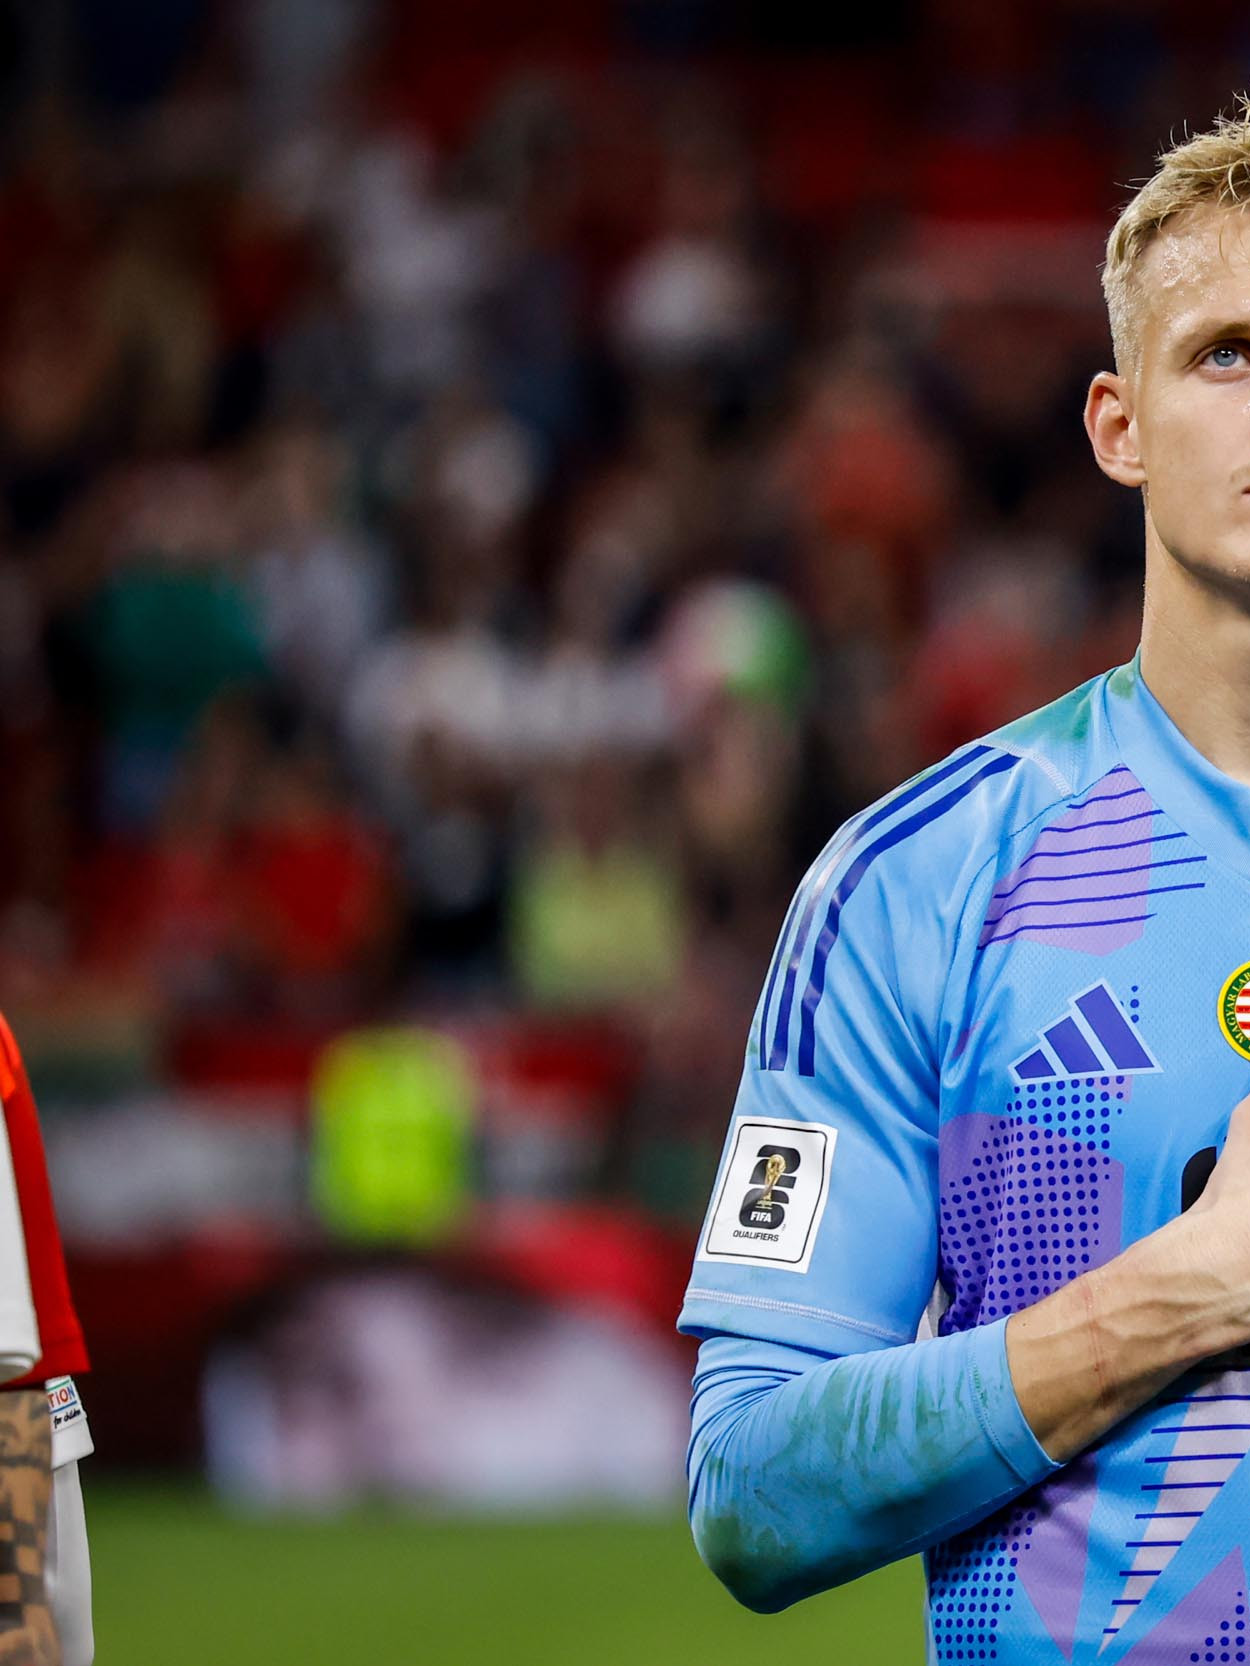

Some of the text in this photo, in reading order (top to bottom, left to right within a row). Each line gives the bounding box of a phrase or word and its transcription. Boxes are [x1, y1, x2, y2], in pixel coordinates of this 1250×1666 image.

[1226, 994, 1246, 1044] MAGYAR
[750, 1211, 772, 1223] FIFA
[732, 1229, 779, 1242] QUALIFIERS
